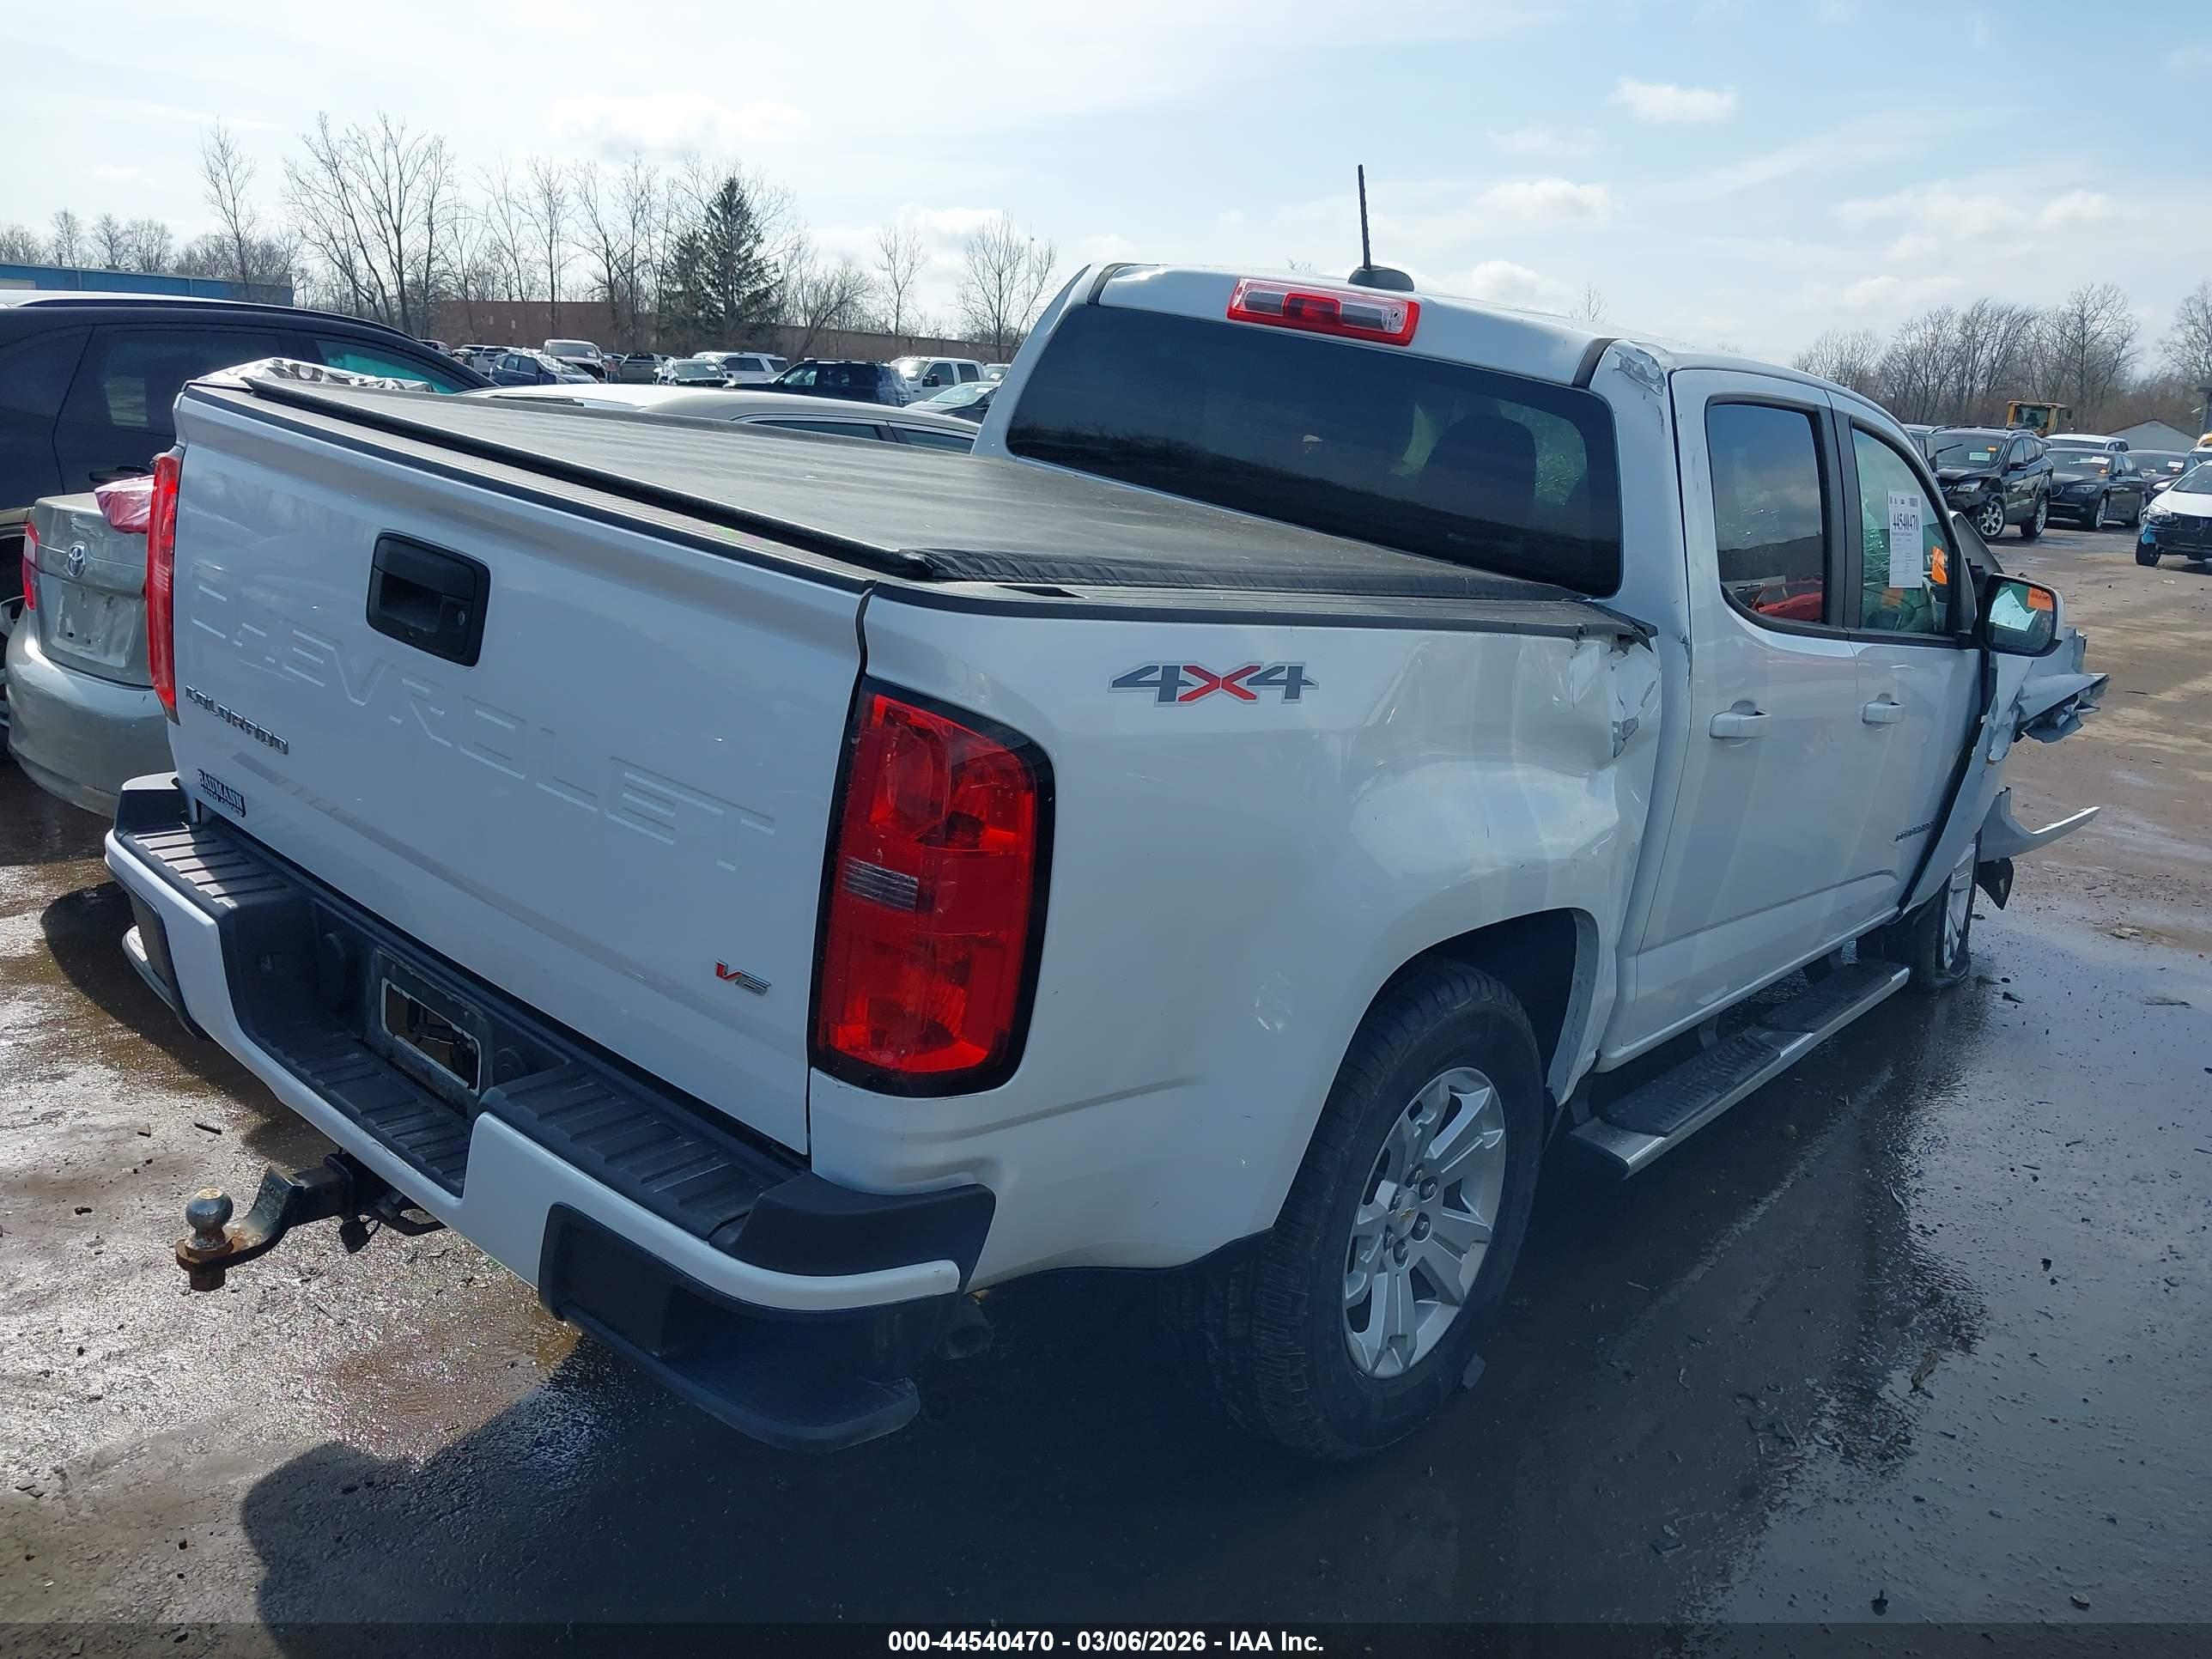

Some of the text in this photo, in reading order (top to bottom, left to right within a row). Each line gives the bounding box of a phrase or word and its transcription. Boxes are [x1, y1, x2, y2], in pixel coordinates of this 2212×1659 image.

[1893, 513, 1919, 532] 44540470
[185, 685, 289, 756] COLORADO
[190, 560, 775, 872] CHEVROLET
[198, 770, 244, 812] BAUMANN
[714, 958, 772, 996] V6
